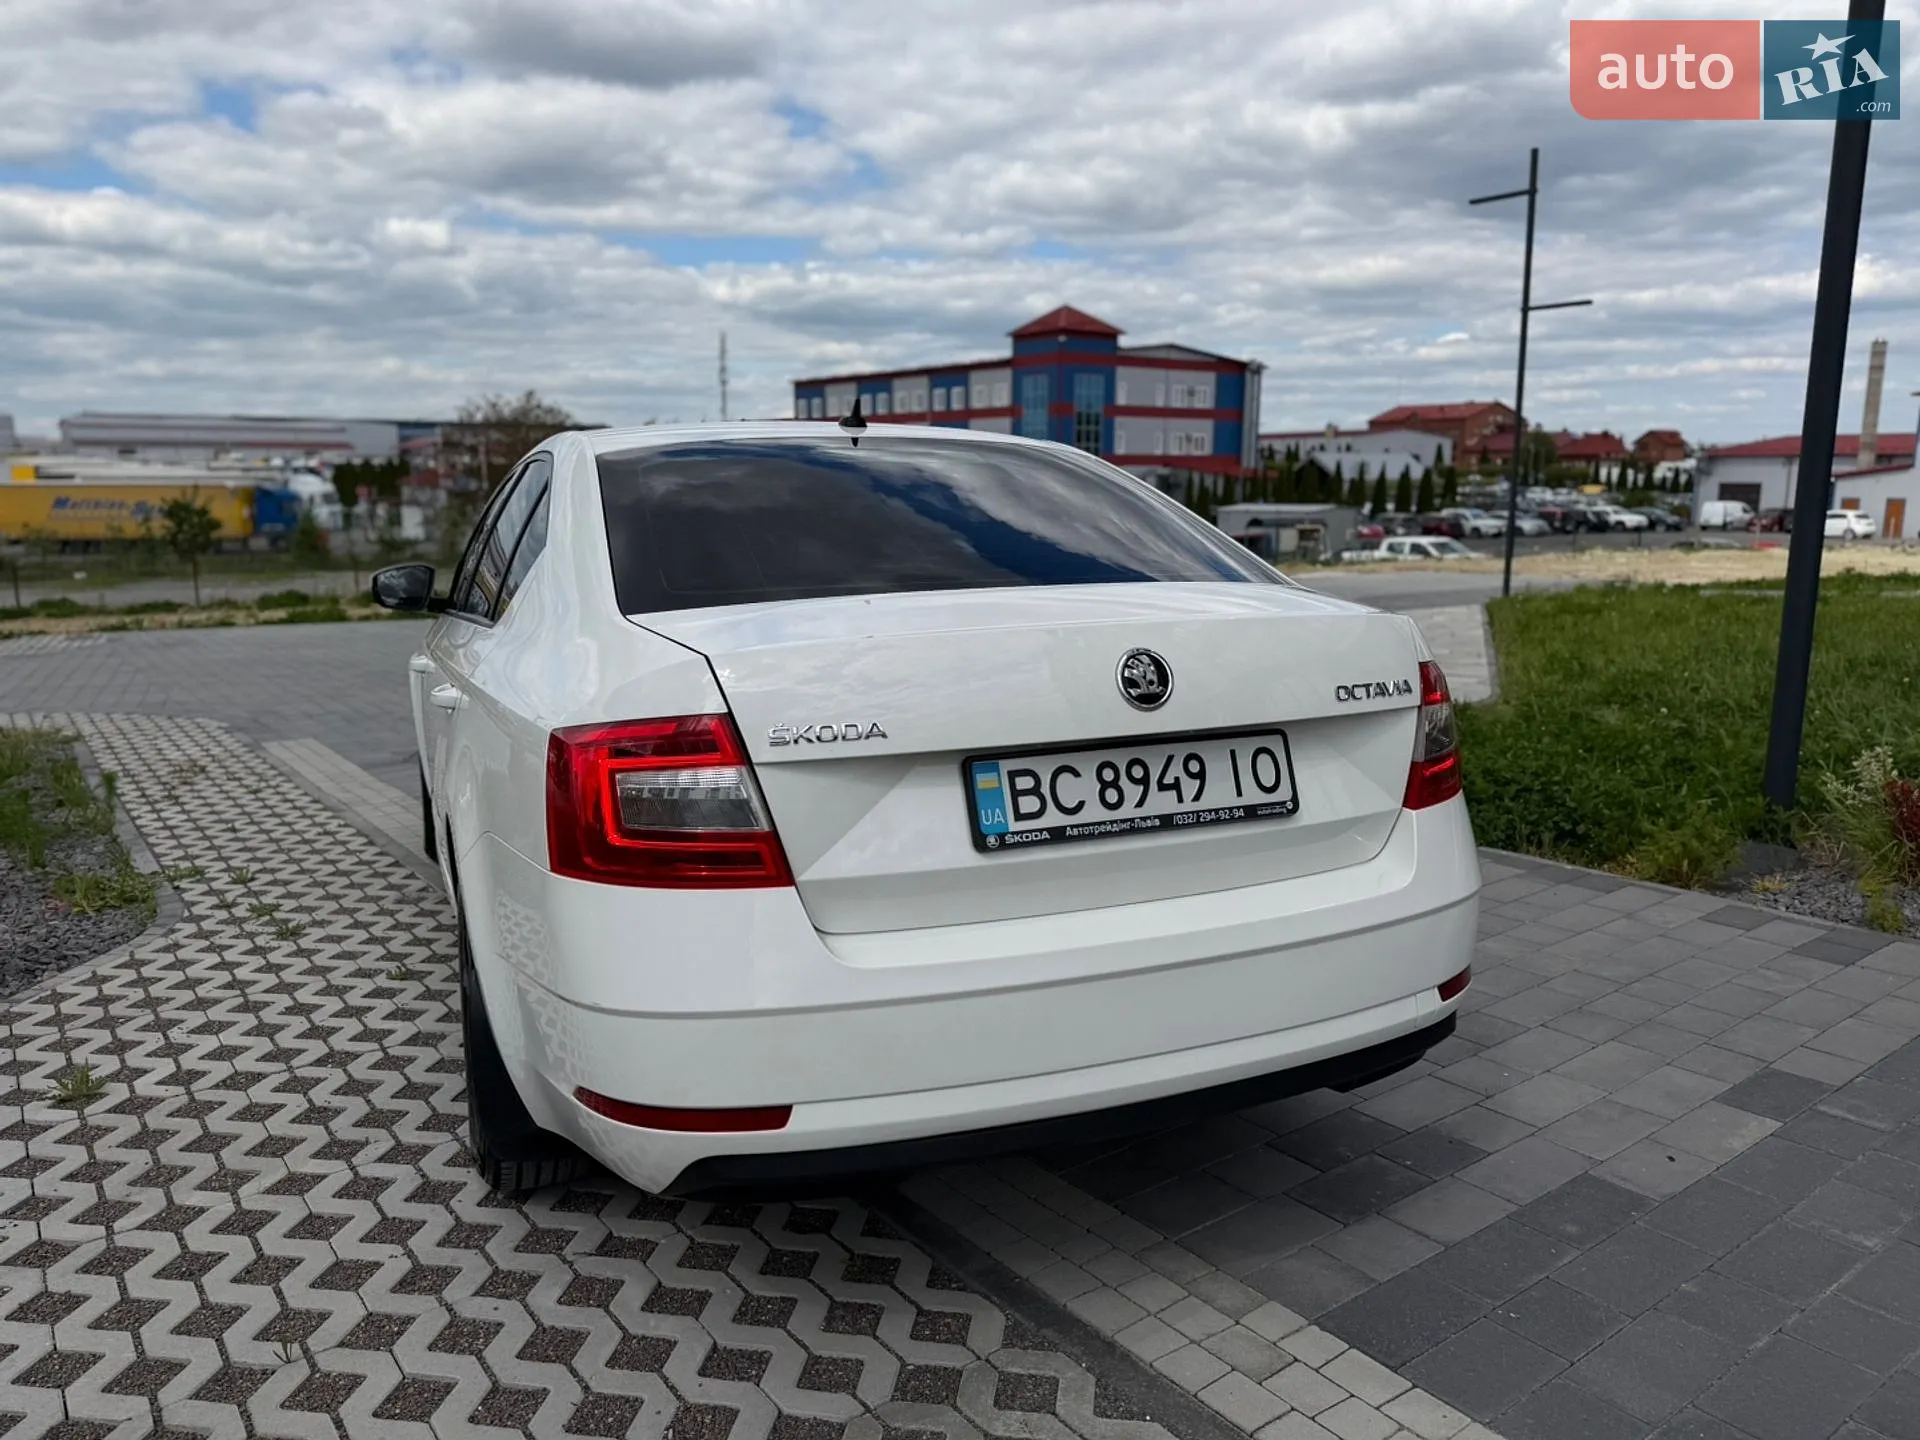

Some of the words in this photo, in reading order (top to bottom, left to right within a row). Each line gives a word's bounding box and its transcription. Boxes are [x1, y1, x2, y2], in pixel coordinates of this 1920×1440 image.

[1335, 679, 1413, 702] OCTAVIA
[768, 721, 888, 747] ŠKODA
[1006, 764, 1086, 822] BC
[1095, 752, 1207, 811] 8949
[1229, 745, 1282, 797] IO
[981, 808, 1005, 826] UA
[1198, 808, 1245, 823] 294-92-94
